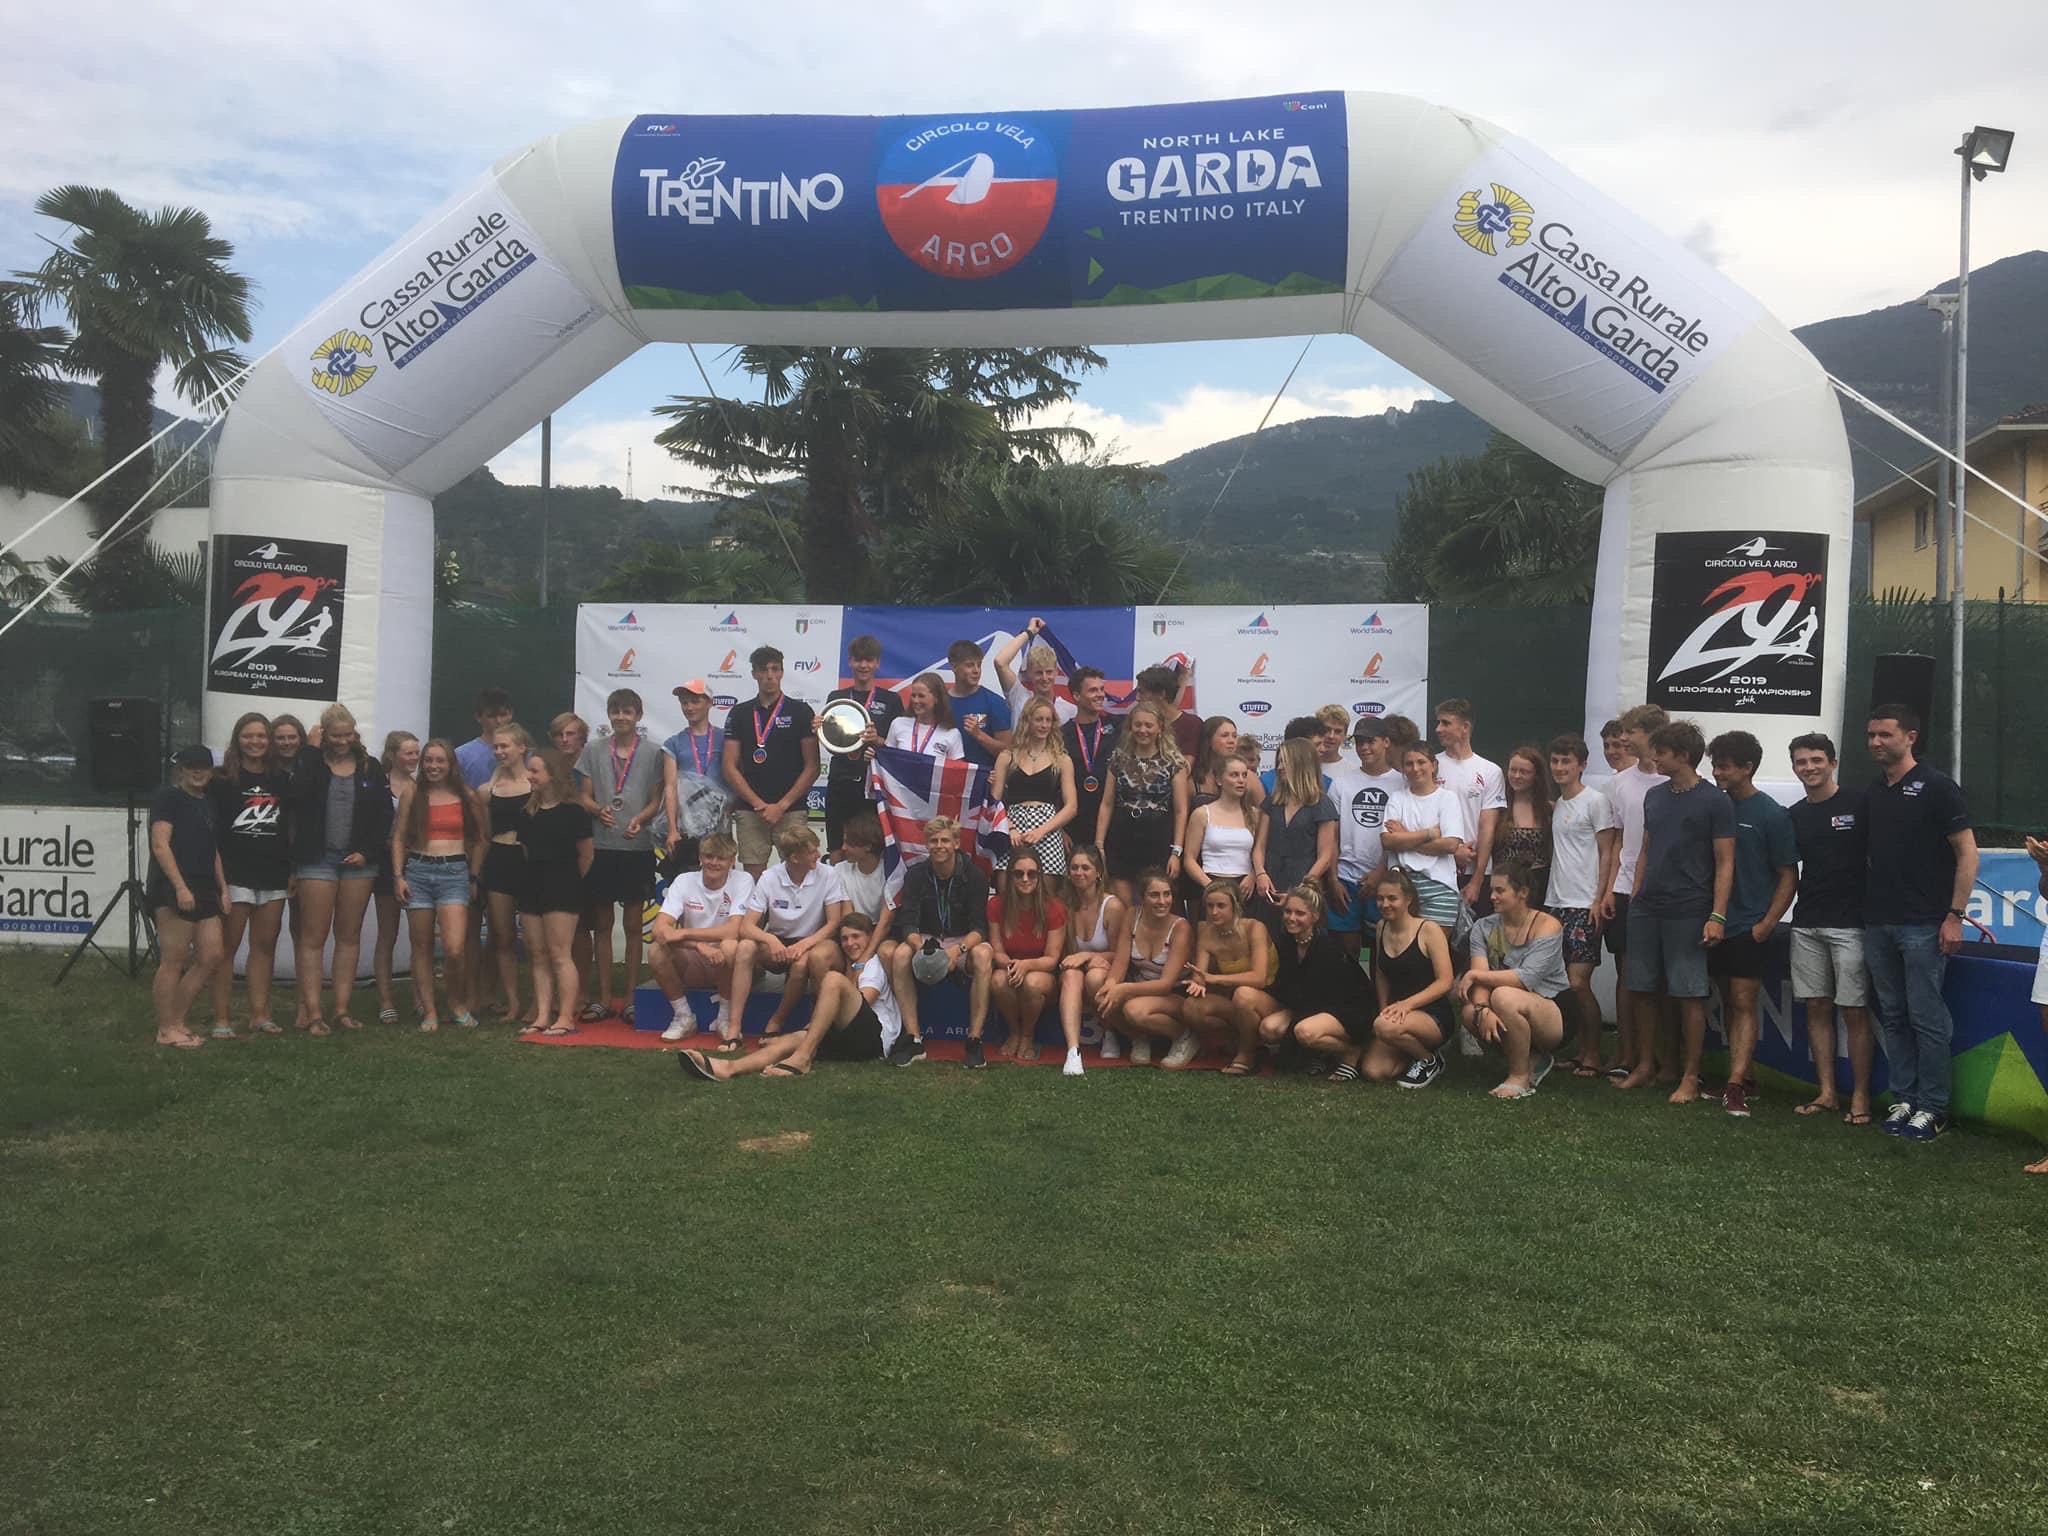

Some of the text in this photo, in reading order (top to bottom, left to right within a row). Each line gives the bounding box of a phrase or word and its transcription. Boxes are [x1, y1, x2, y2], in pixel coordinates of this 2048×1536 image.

[905, 121, 1035, 151] CIRCOLO VELA
[1143, 128, 1286, 149] NORTH LAKE
[1106, 145, 1322, 202] GARDA
[640, 168, 844, 226] TRENTINO
[1119, 199, 1306, 226] TRENTINO ITALY
[920, 232, 1013, 267] ARCO
[360, 212, 507, 329] Cassa Rurale
[1539, 222, 1709, 353] Cassa Rurale
[381, 238, 529, 362] Alto Garda
[1507, 279, 1536, 302] Banca
[1554, 311, 1591, 341] Credito
[1505, 251, 1680, 384] Alto Garda
[263, 562, 283, 571] VELA
[284, 564, 308, 573] ARCO
[1704, 559, 1798, 568] CIRCOLO VELA ARCO
[1258, 628, 1279, 636] Sailing
[1371, 627, 1393, 635] Sailing
[248, 662, 277, 672] 2019
[794, 661, 813, 671] FIV
[250, 672, 324, 684] CHAMPIONSHIP
[1729, 675, 1767, 685] 2019
[1668, 685, 1812, 697] EUROPEAN CHAMPIONSHIP
[1362, 791, 1384, 803] N
[1361, 811, 1379, 823] S
[0, 825, 95, 868] urale
[0, 875, 92, 919] arda
[2, 922, 80, 933] ooperativo
